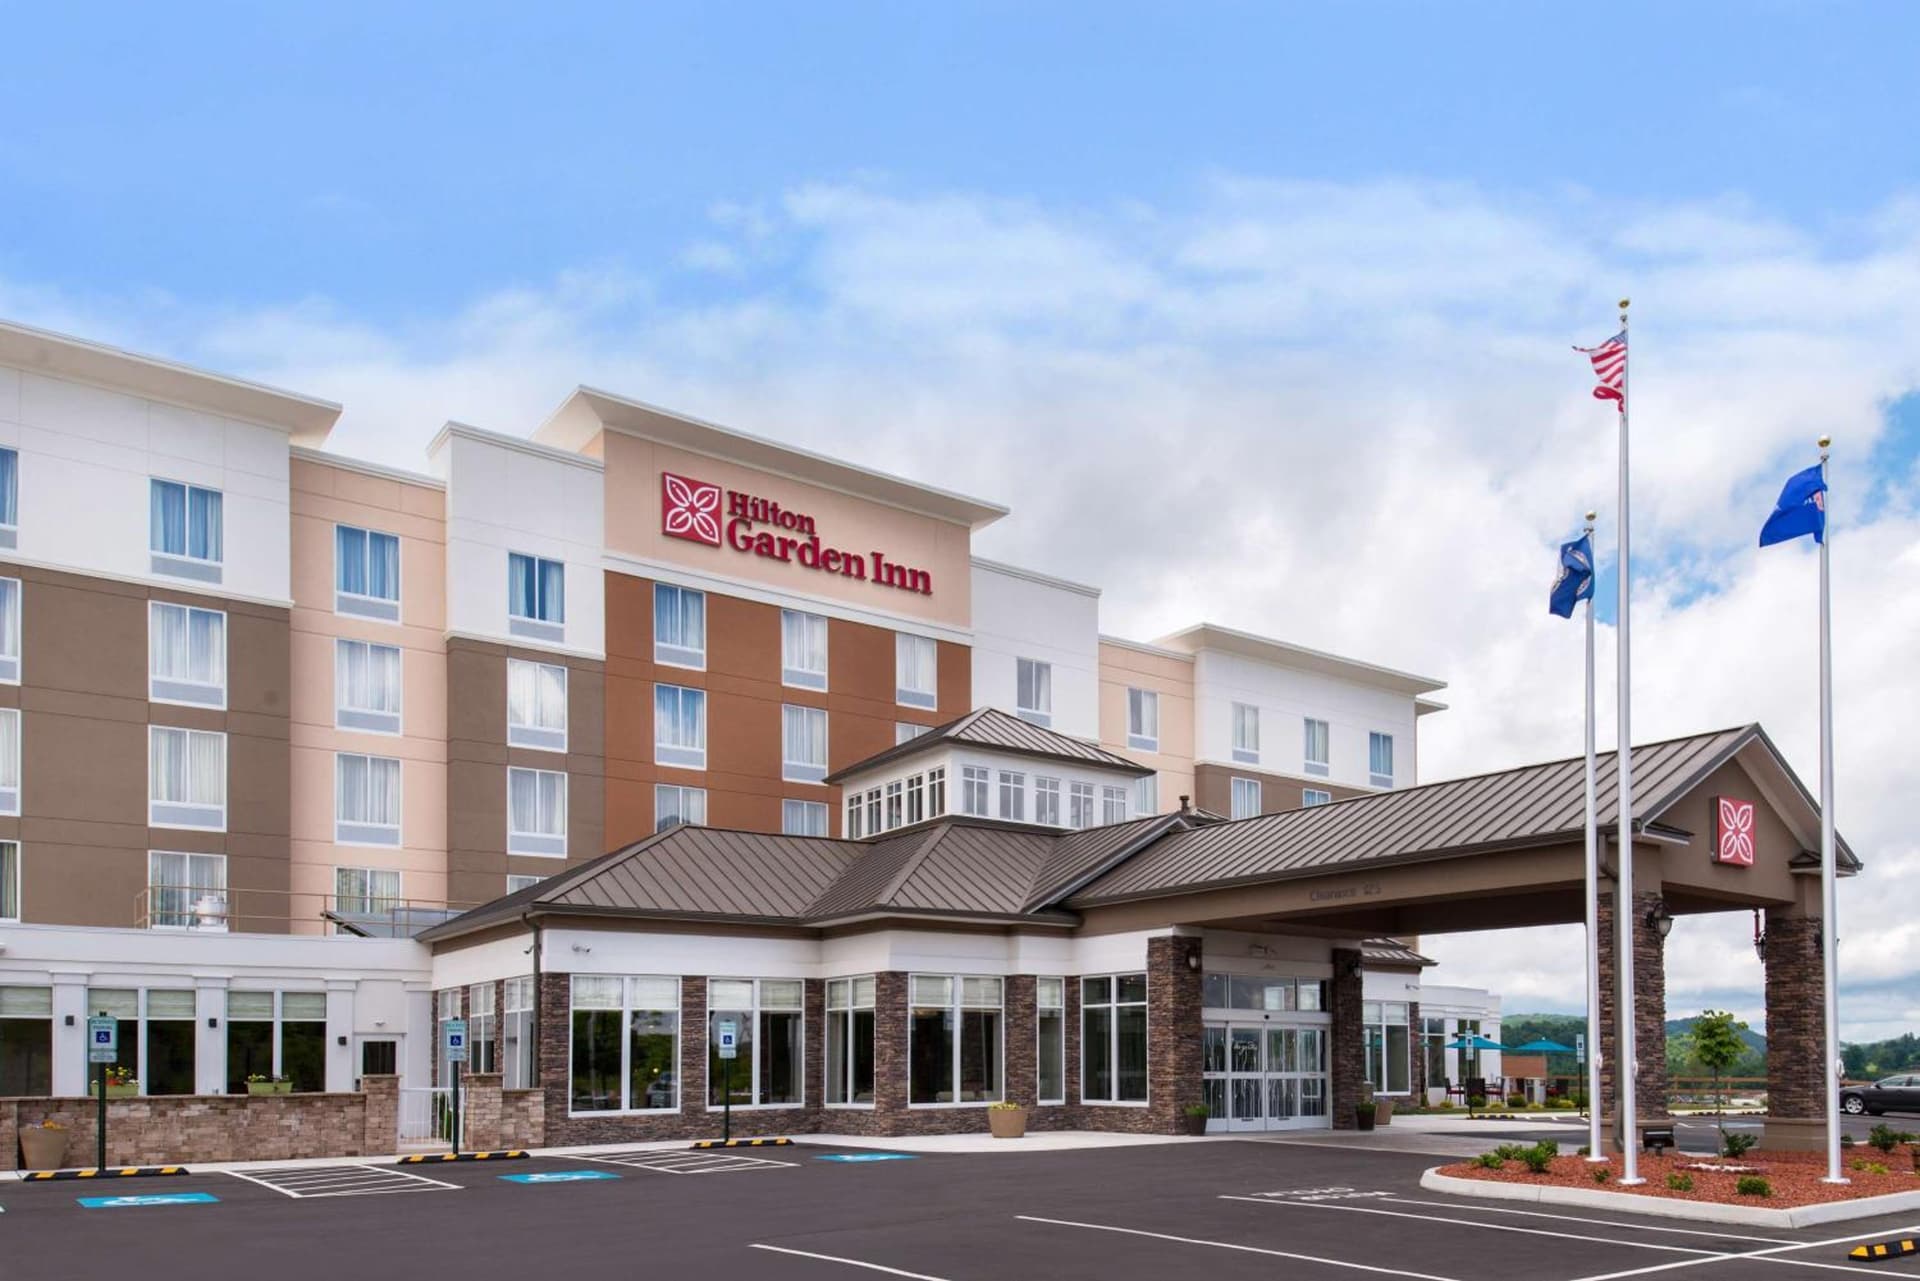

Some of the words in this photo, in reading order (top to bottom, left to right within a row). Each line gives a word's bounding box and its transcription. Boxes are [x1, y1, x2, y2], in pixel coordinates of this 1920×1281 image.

[727, 490, 816, 535] Hilton
[727, 518, 867, 581] Garden
[870, 551, 932, 595] Inn
